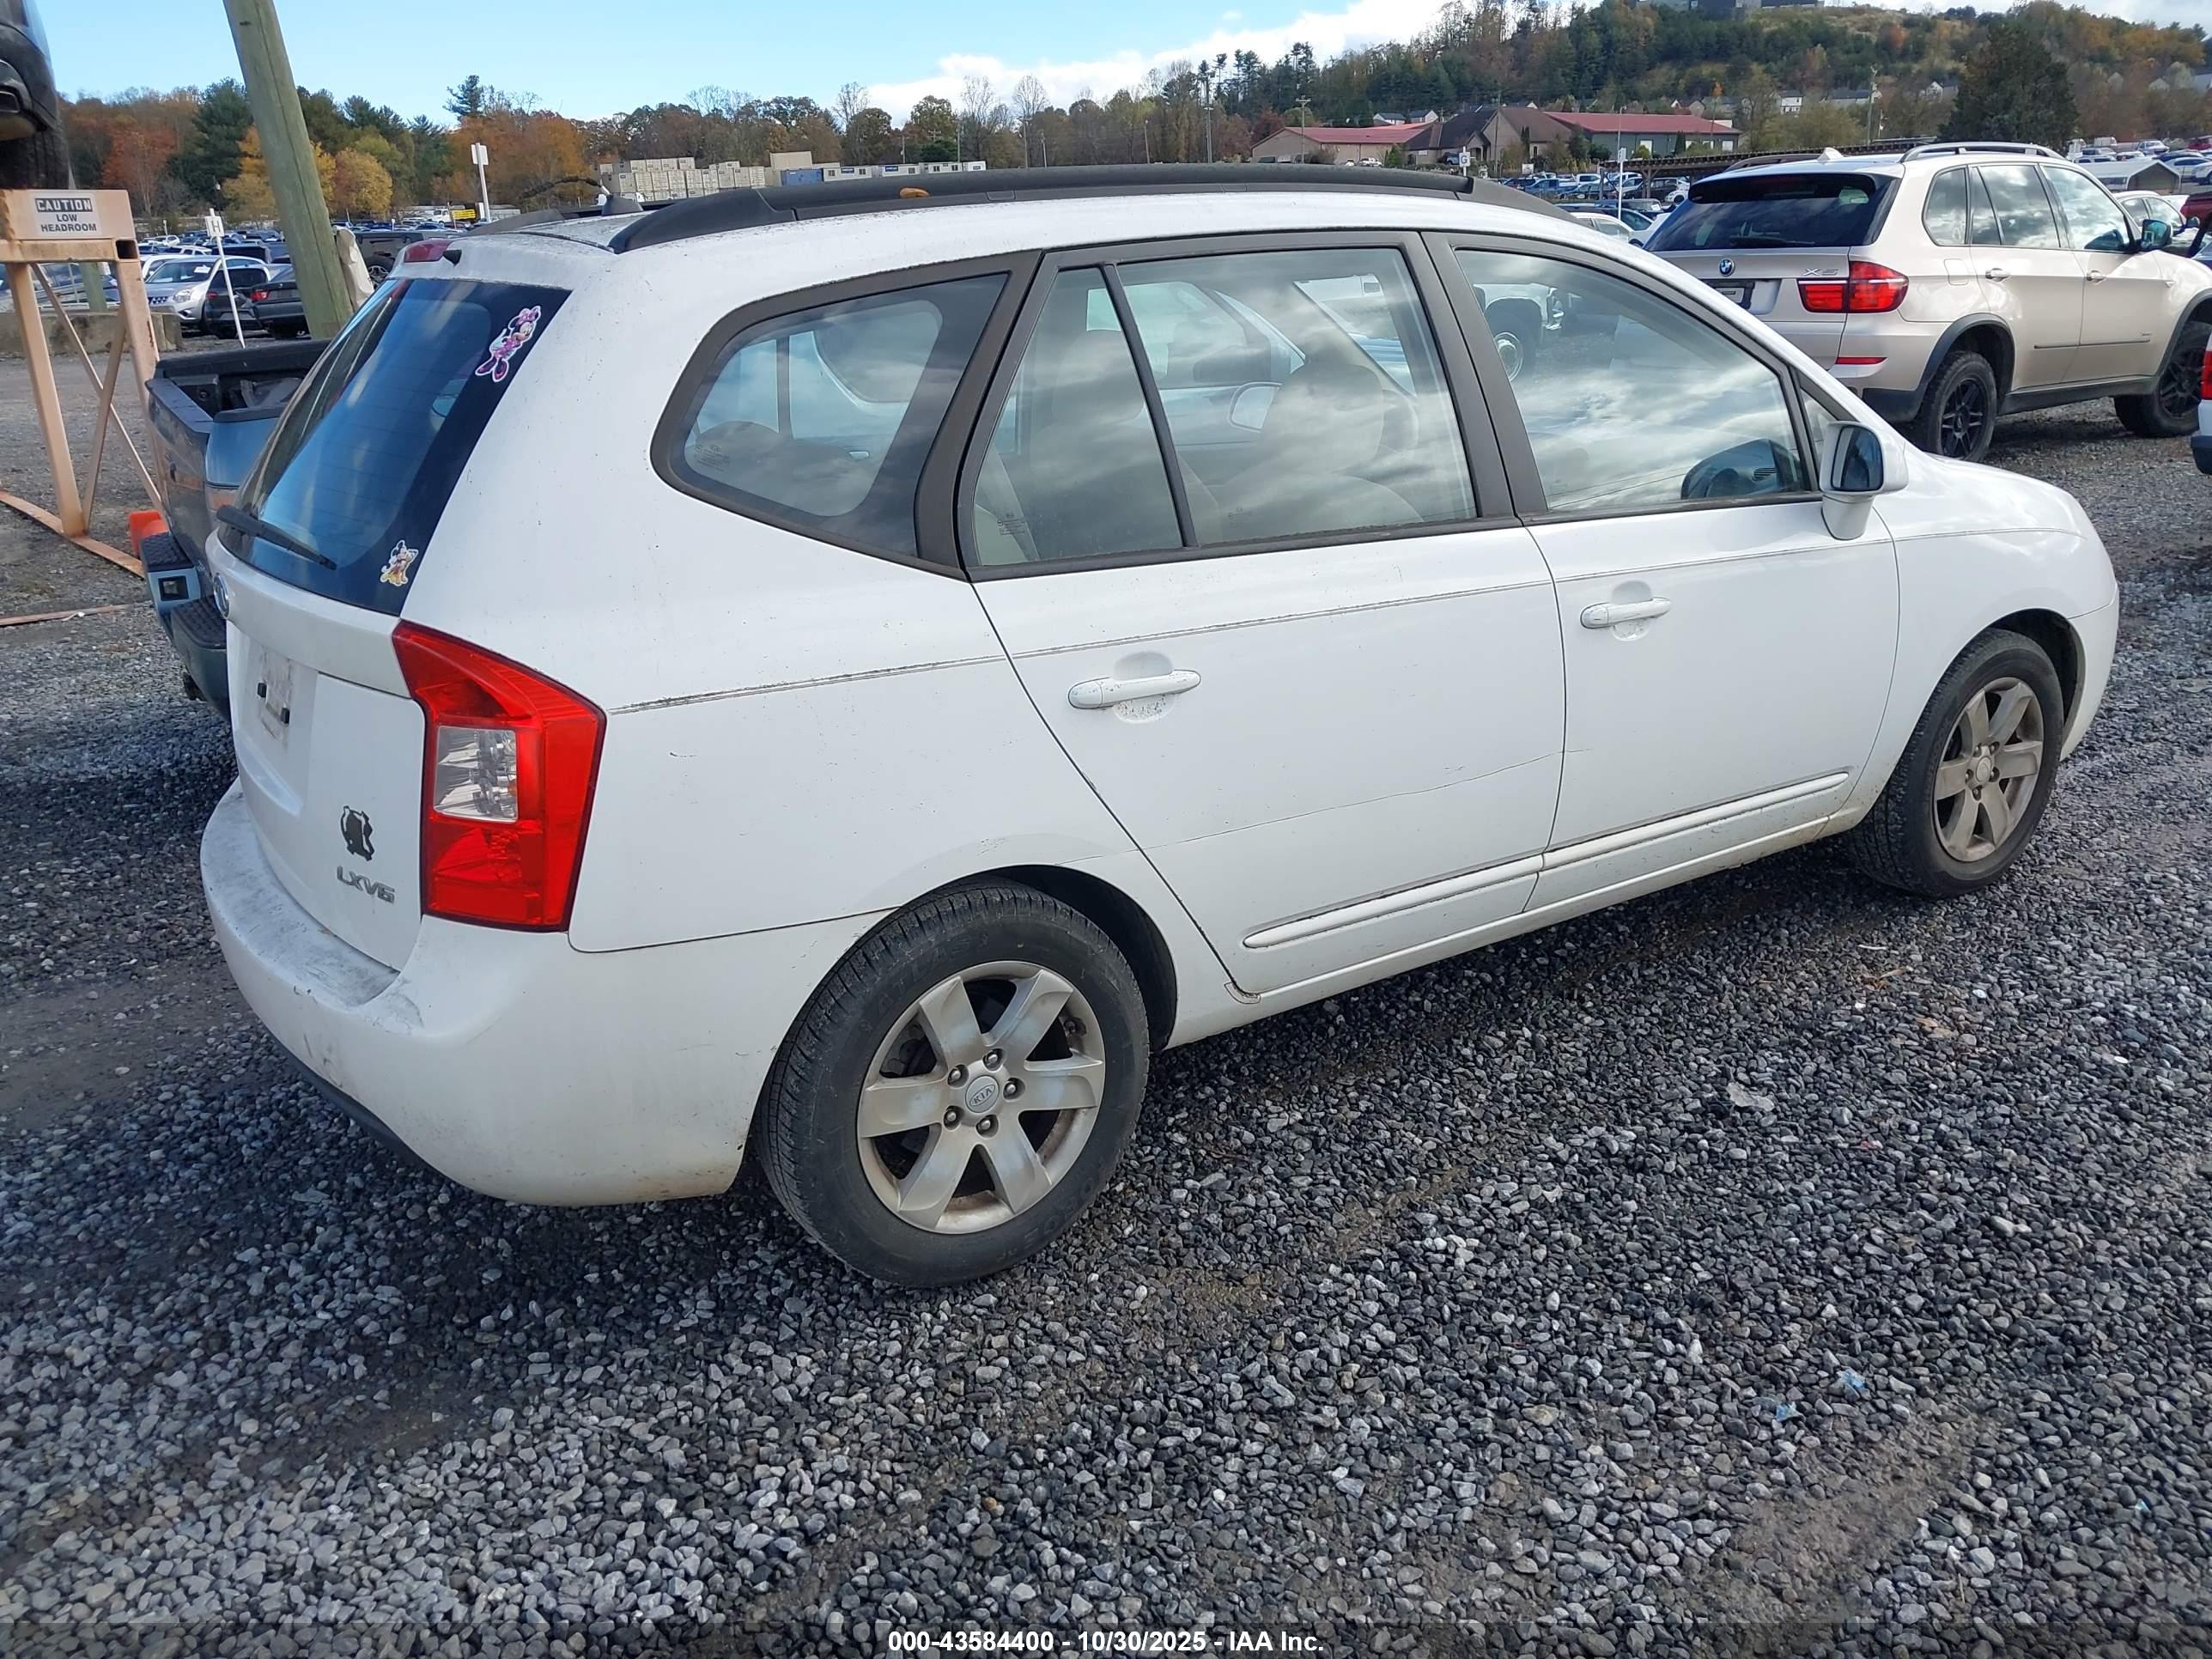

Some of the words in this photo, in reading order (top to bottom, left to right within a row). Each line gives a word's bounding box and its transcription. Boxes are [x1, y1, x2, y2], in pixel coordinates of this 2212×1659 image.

[1461, 155, 1468, 164] G
[36, 199, 92, 211] CAUTION
[56, 214, 77, 222] LOW
[40, 223, 97, 233] HEADROOM
[211, 220, 221, 233] H
[973, 1087, 993, 1104] KIA
